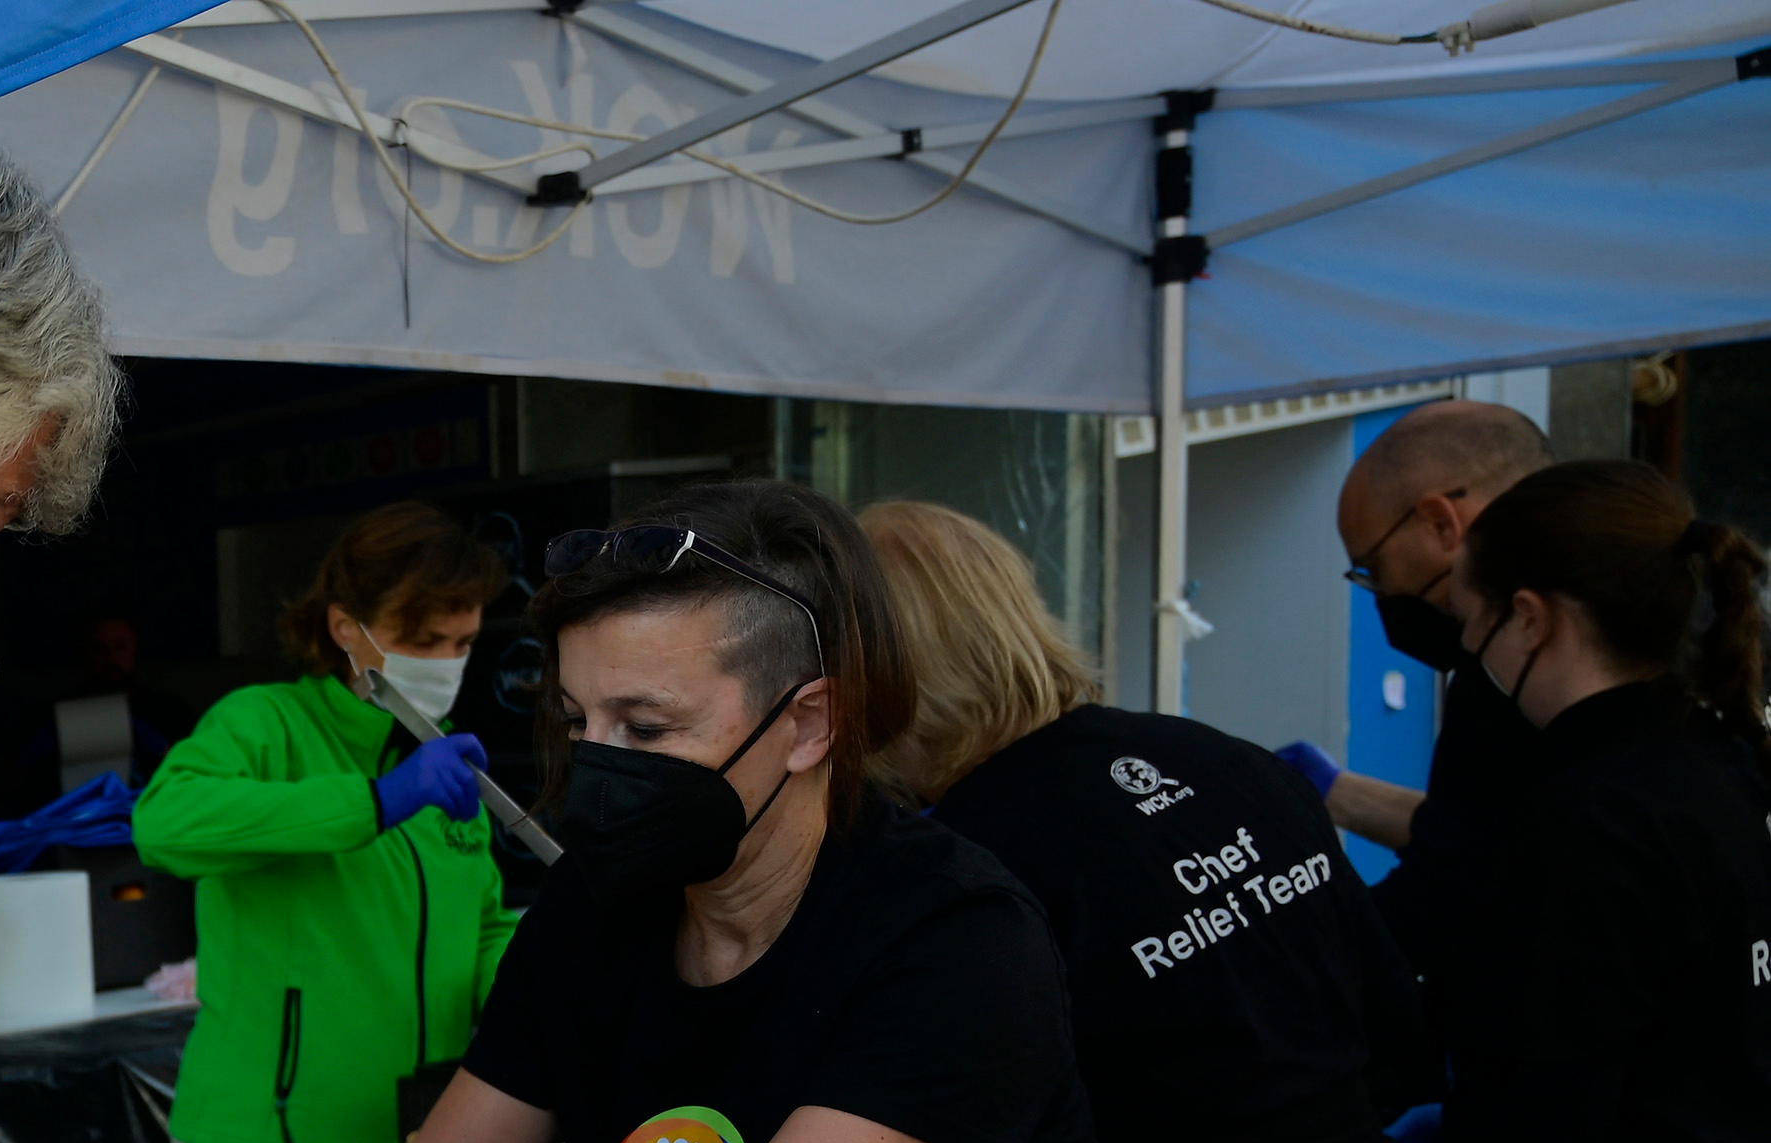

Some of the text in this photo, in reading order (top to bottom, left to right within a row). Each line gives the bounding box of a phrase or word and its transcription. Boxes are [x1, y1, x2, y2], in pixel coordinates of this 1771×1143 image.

[1135, 785, 1195, 816] WCK.org
[1172, 826, 1261, 895] Chef
[1130, 891, 1250, 979] Relief
[1751, 939, 1771, 987] R
